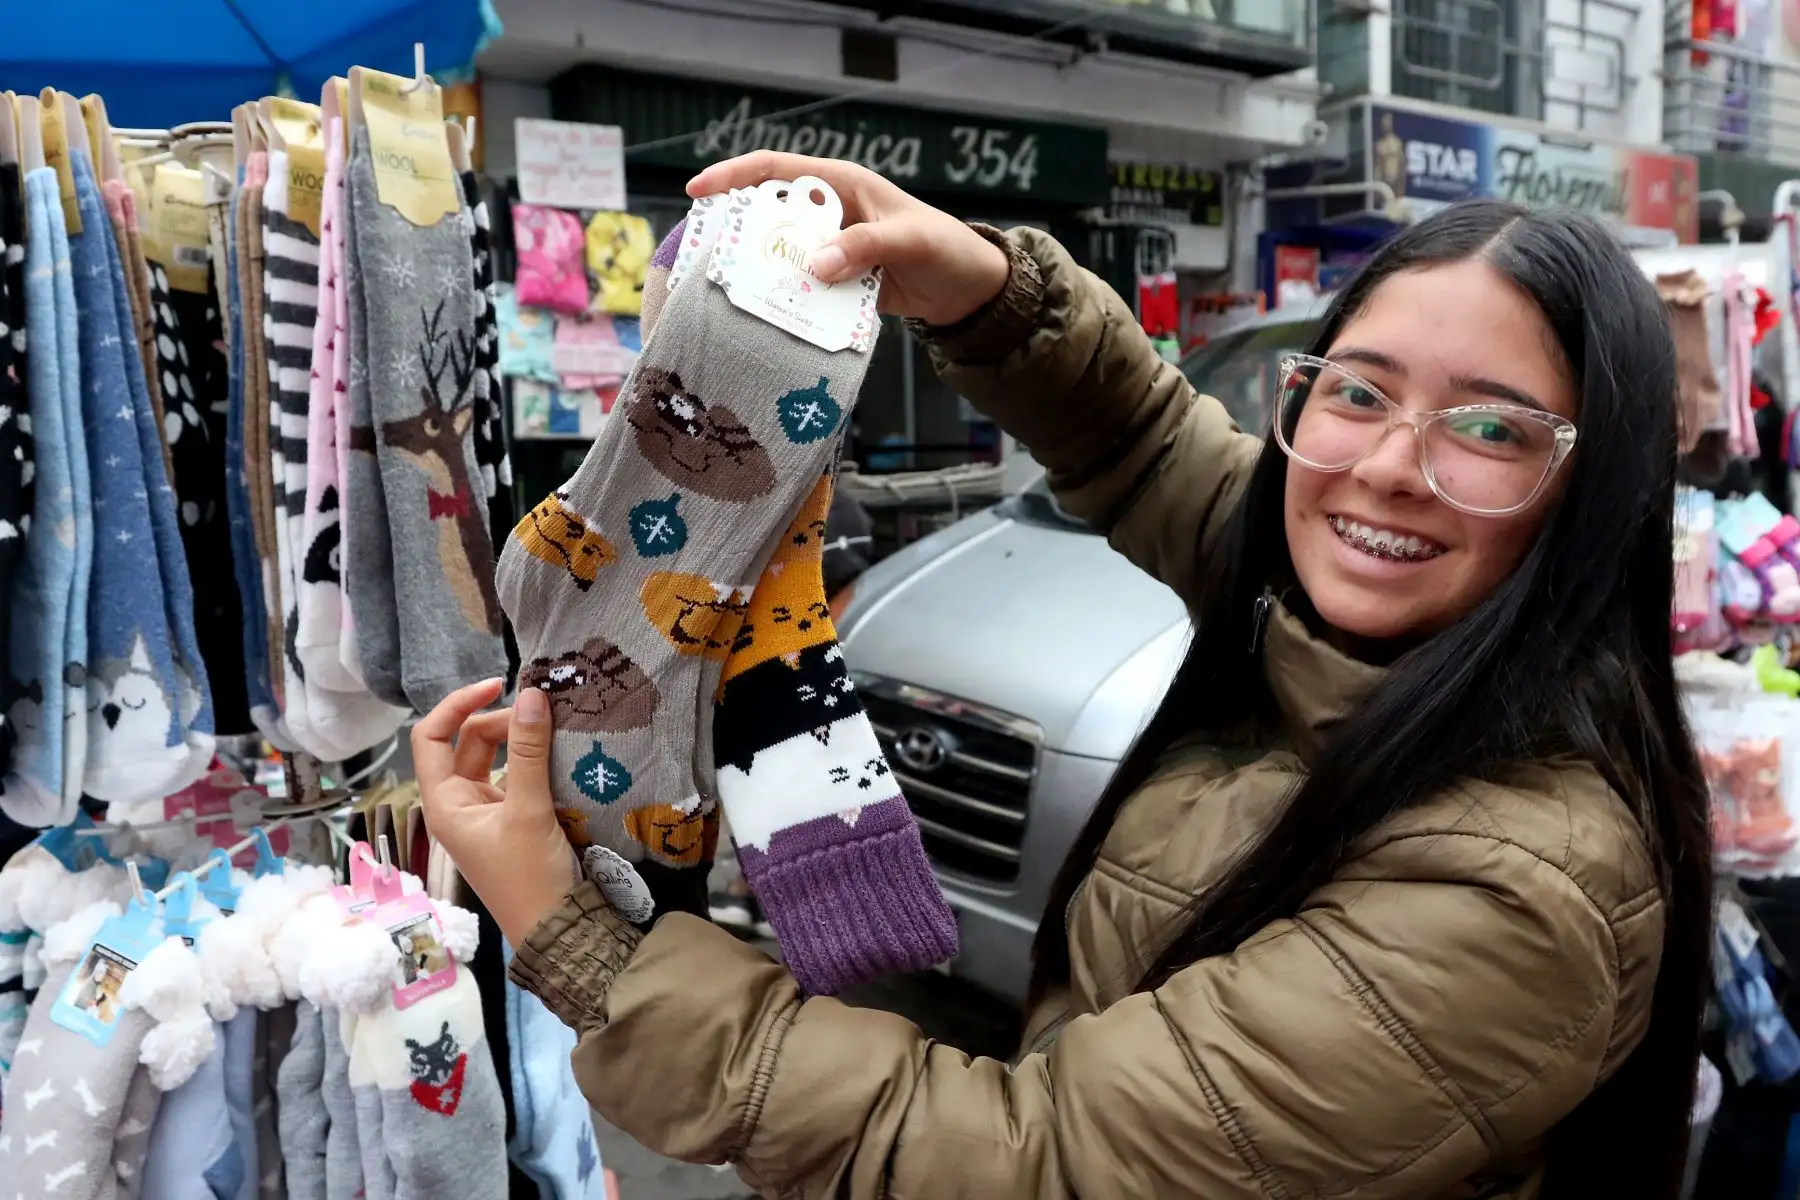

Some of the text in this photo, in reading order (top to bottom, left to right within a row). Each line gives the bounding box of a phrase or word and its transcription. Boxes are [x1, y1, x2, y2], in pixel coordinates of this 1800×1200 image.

[376, 151, 418, 174] WOOL
[945, 126, 1037, 191] 354
[1405, 140, 1478, 182] STAR
[596, 871, 632, 888] Qiling
